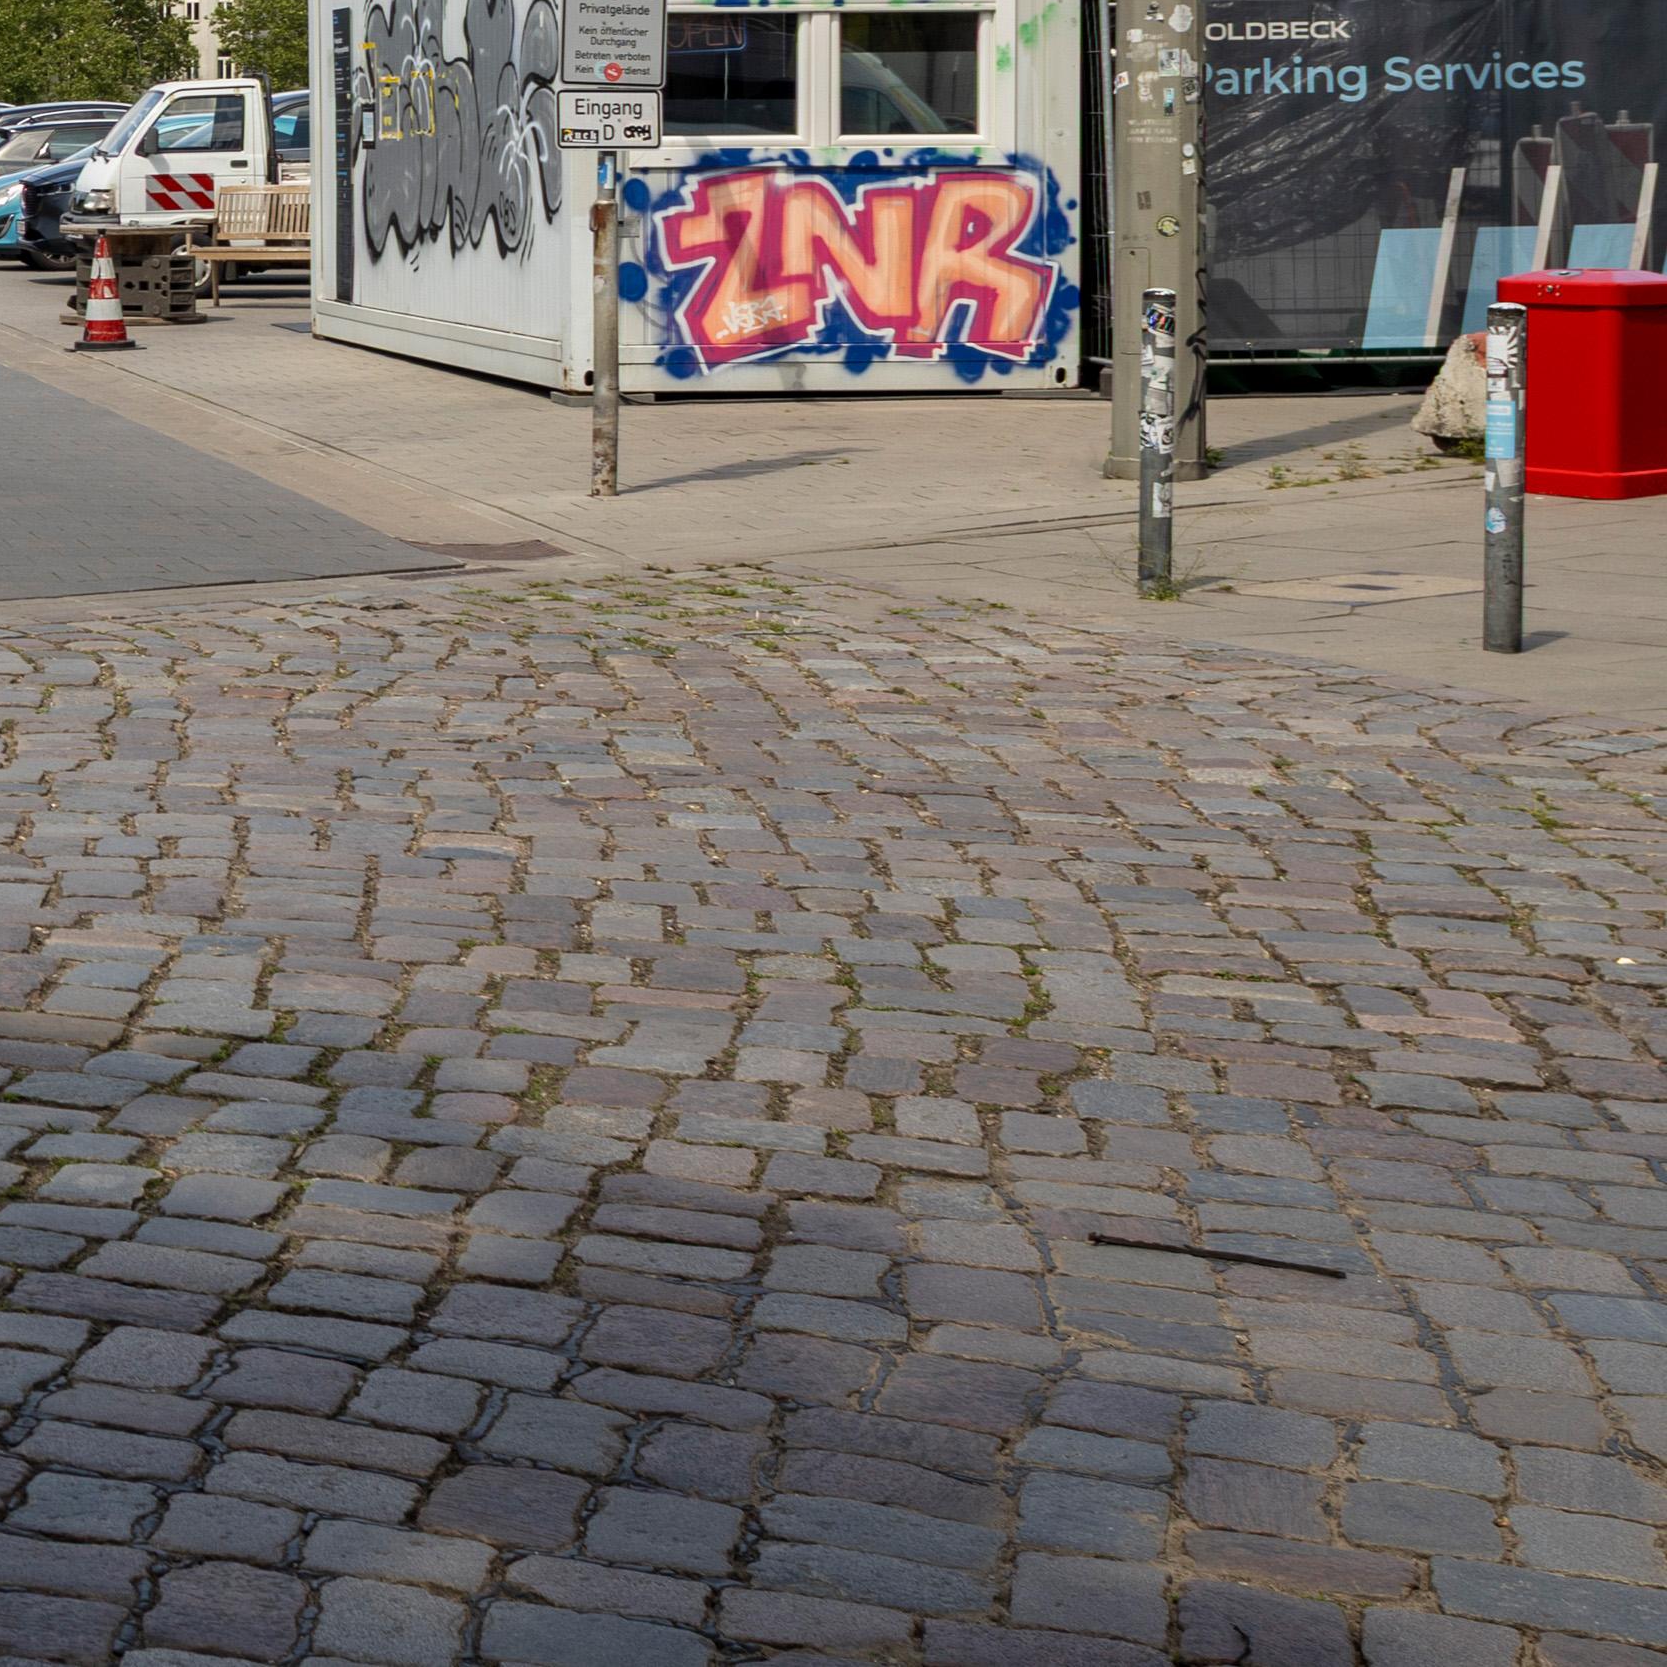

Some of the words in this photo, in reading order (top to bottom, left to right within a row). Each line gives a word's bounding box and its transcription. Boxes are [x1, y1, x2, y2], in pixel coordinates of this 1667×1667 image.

[579, 2, 650, 17] Privatgelände
[579, 25, 598, 34] Kein
[600, 25, 649, 37] öffentlicher
[590, 37, 636, 49] Durchgang
[575, 51, 611, 60] Betreten
[613, 51, 651, 61] verboten
[575, 64, 594, 74] Kein
[1204, 55, 1367, 102] arking
[1384, 51, 1586, 93] Services
[575, 98, 643, 119] Eingang
[603, 124, 614, 141] D
